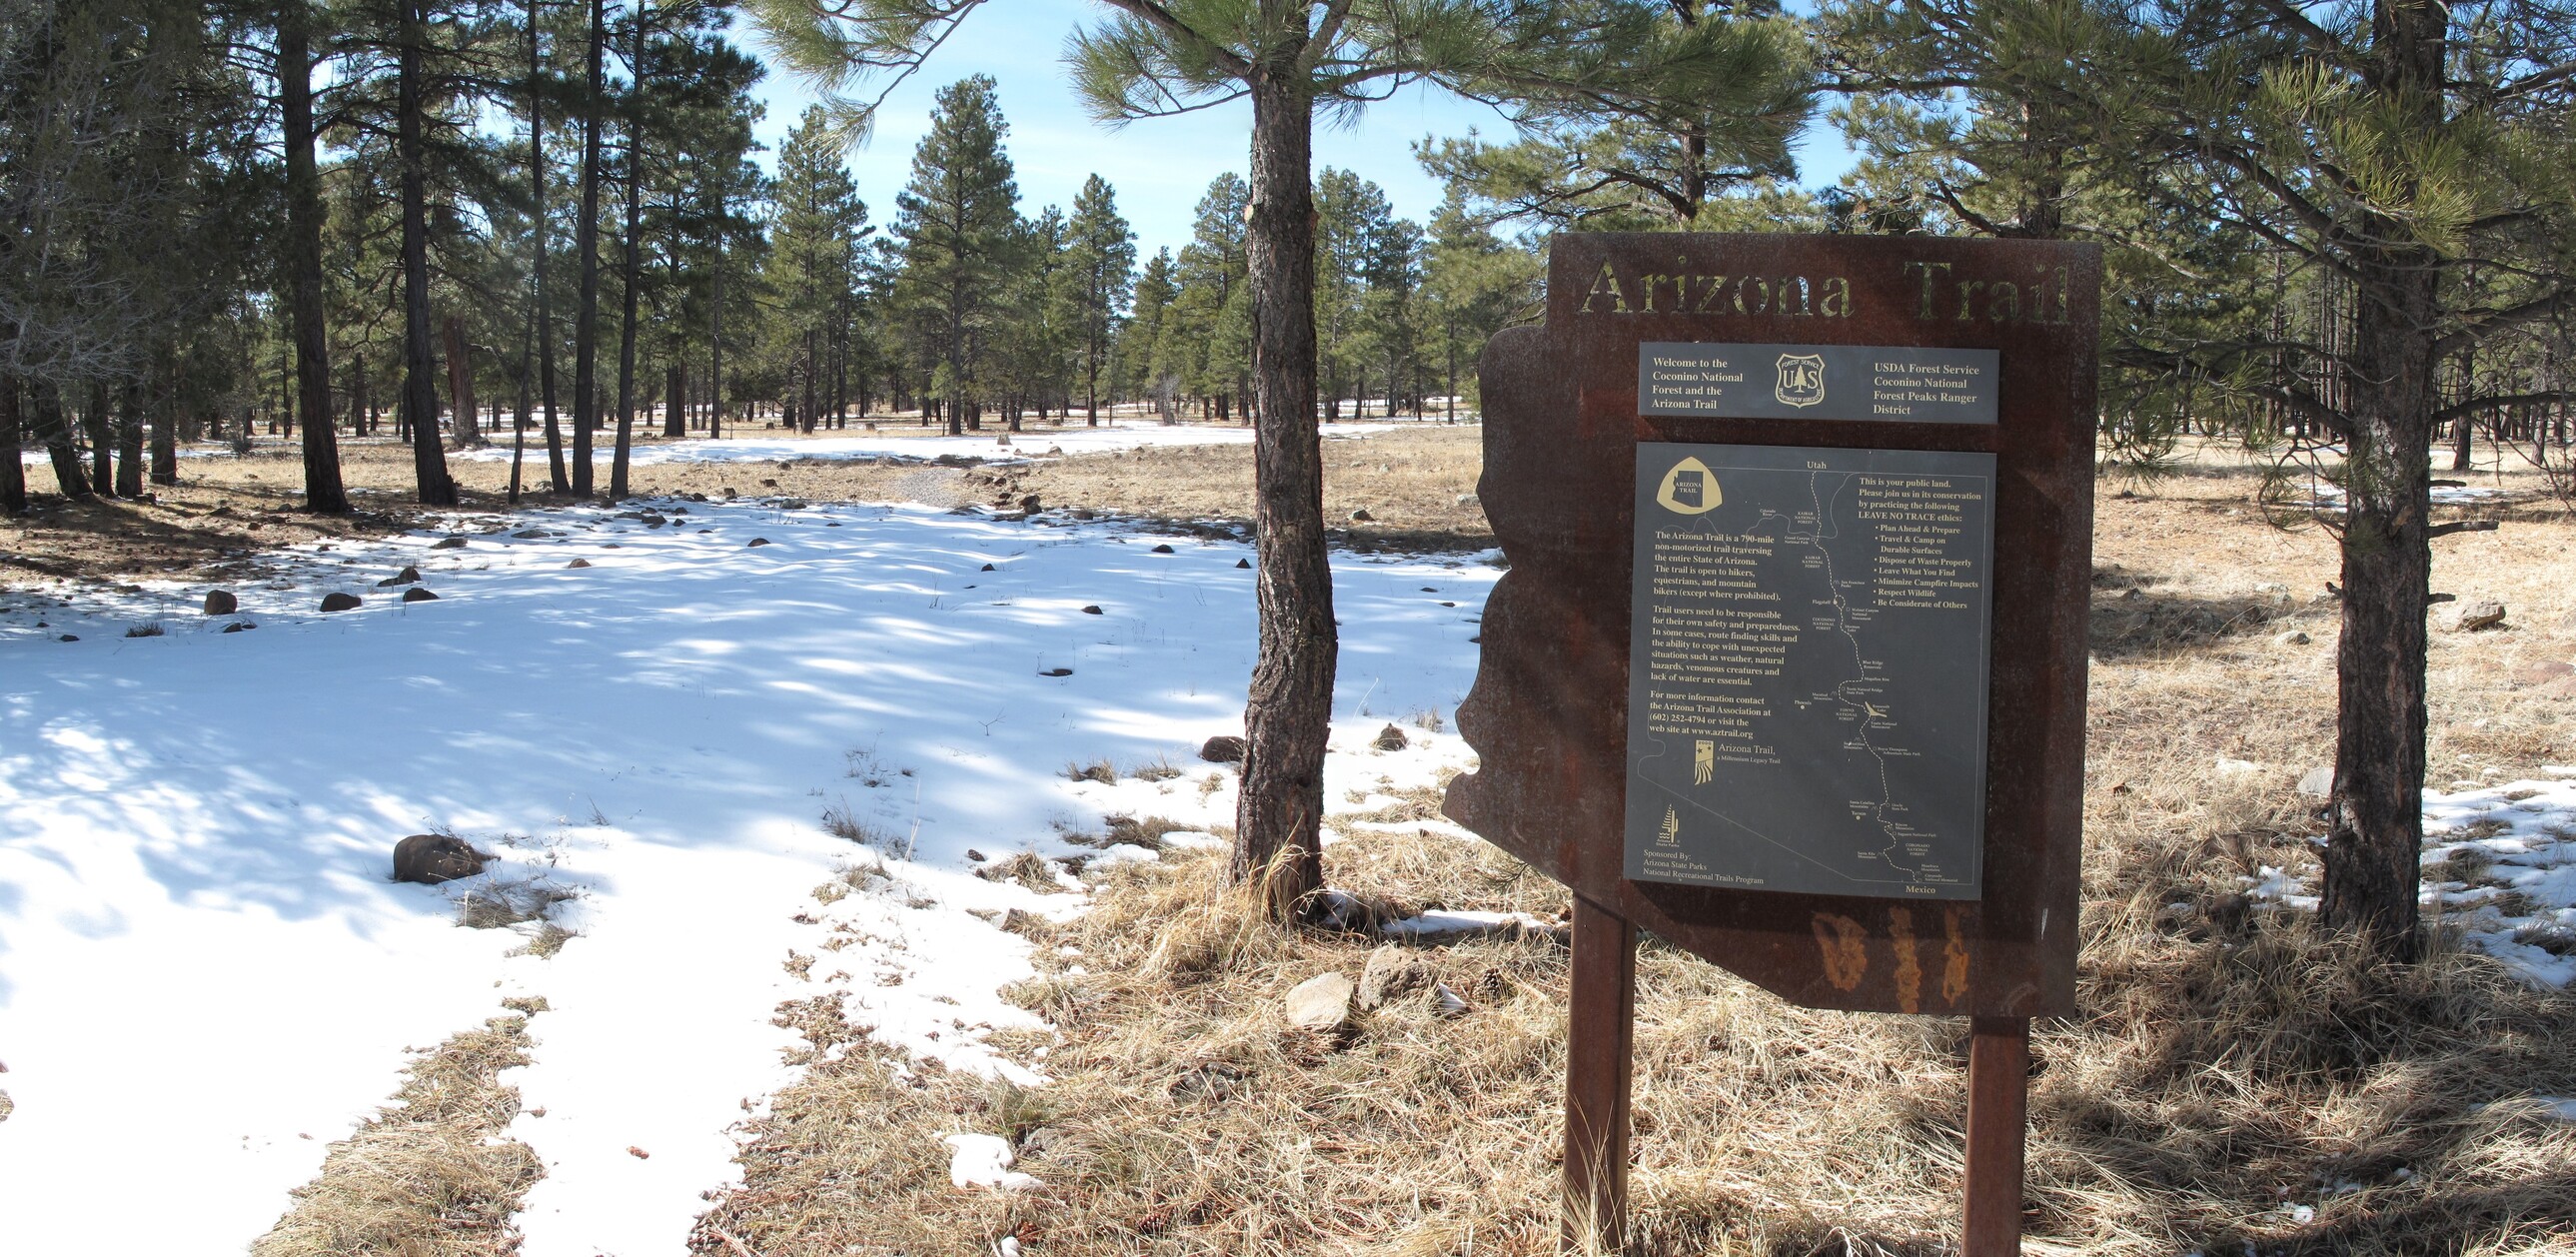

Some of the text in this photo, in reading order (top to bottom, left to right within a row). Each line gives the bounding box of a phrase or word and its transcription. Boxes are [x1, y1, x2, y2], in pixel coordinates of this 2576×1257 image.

[1580, 255, 2071, 325] Arizona Trail
[1654, 358, 1697, 367] Welcome
[1713, 359, 1728, 368] the
[1781, 360, 1819, 370] FOREST SERVICE
[1875, 363, 1980, 375] USDA Forest Service
[1653, 372, 1743, 382] Coconino National
[1874, 377, 1967, 388] Coconino National
[1653, 385, 1682, 394] Forest
[1707, 386, 1722, 395] the
[1874, 390, 1977, 404] Forest Peaks Ranger
[1652, 399, 1717, 409] Arizona Trail
[1874, 404, 1911, 414] District
[1906, 479, 1930, 488] public
[1884, 490, 1900, 498] join
[1859, 500, 1868, 509] by
[1870, 501, 1909, 510] practicing
[1925, 502, 1960, 512] following
[1932, 526, 1961, 535] Prepare
[1705, 533, 1725, 542] Trail
[1741, 534, 1775, 543] 790-mile
[1913, 536, 1935, 545] Camp
[1732, 546, 1772, 556] traversing
[1941, 559, 1972, 568] Properly
[1729, 568, 1755, 577] hikers,
[1654, 577, 1700, 586] equestrians,
[1914, 579, 1948, 588] Campfire
[1950, 581, 1979, 589] Impacts
[1679, 589, 1707, 599] (except
[1735, 591, 1781, 601] prohibited).
[1889, 600, 1932, 608] Considerate
[1688, 693, 1734, 703] information
[1664, 703, 1694, 712] Arizona
[1717, 706, 1761, 716] Association
[1649, 713, 1669, 722] (602)
[1671, 714, 1706, 724] 252-4794
[1719, 717, 1734, 726] visit
[1692, 729, 1753, 739] www.aztrail.org
[1719, 743, 1776, 756] Arizona Trail,
[1644, 850, 1691, 861] Sponsored By:
[1644, 859, 1670, 868] Arizona
[1643, 868, 1671, 877] National
[1673, 870, 1713, 880] Recreational
[1736, 876, 1764, 884] Program
